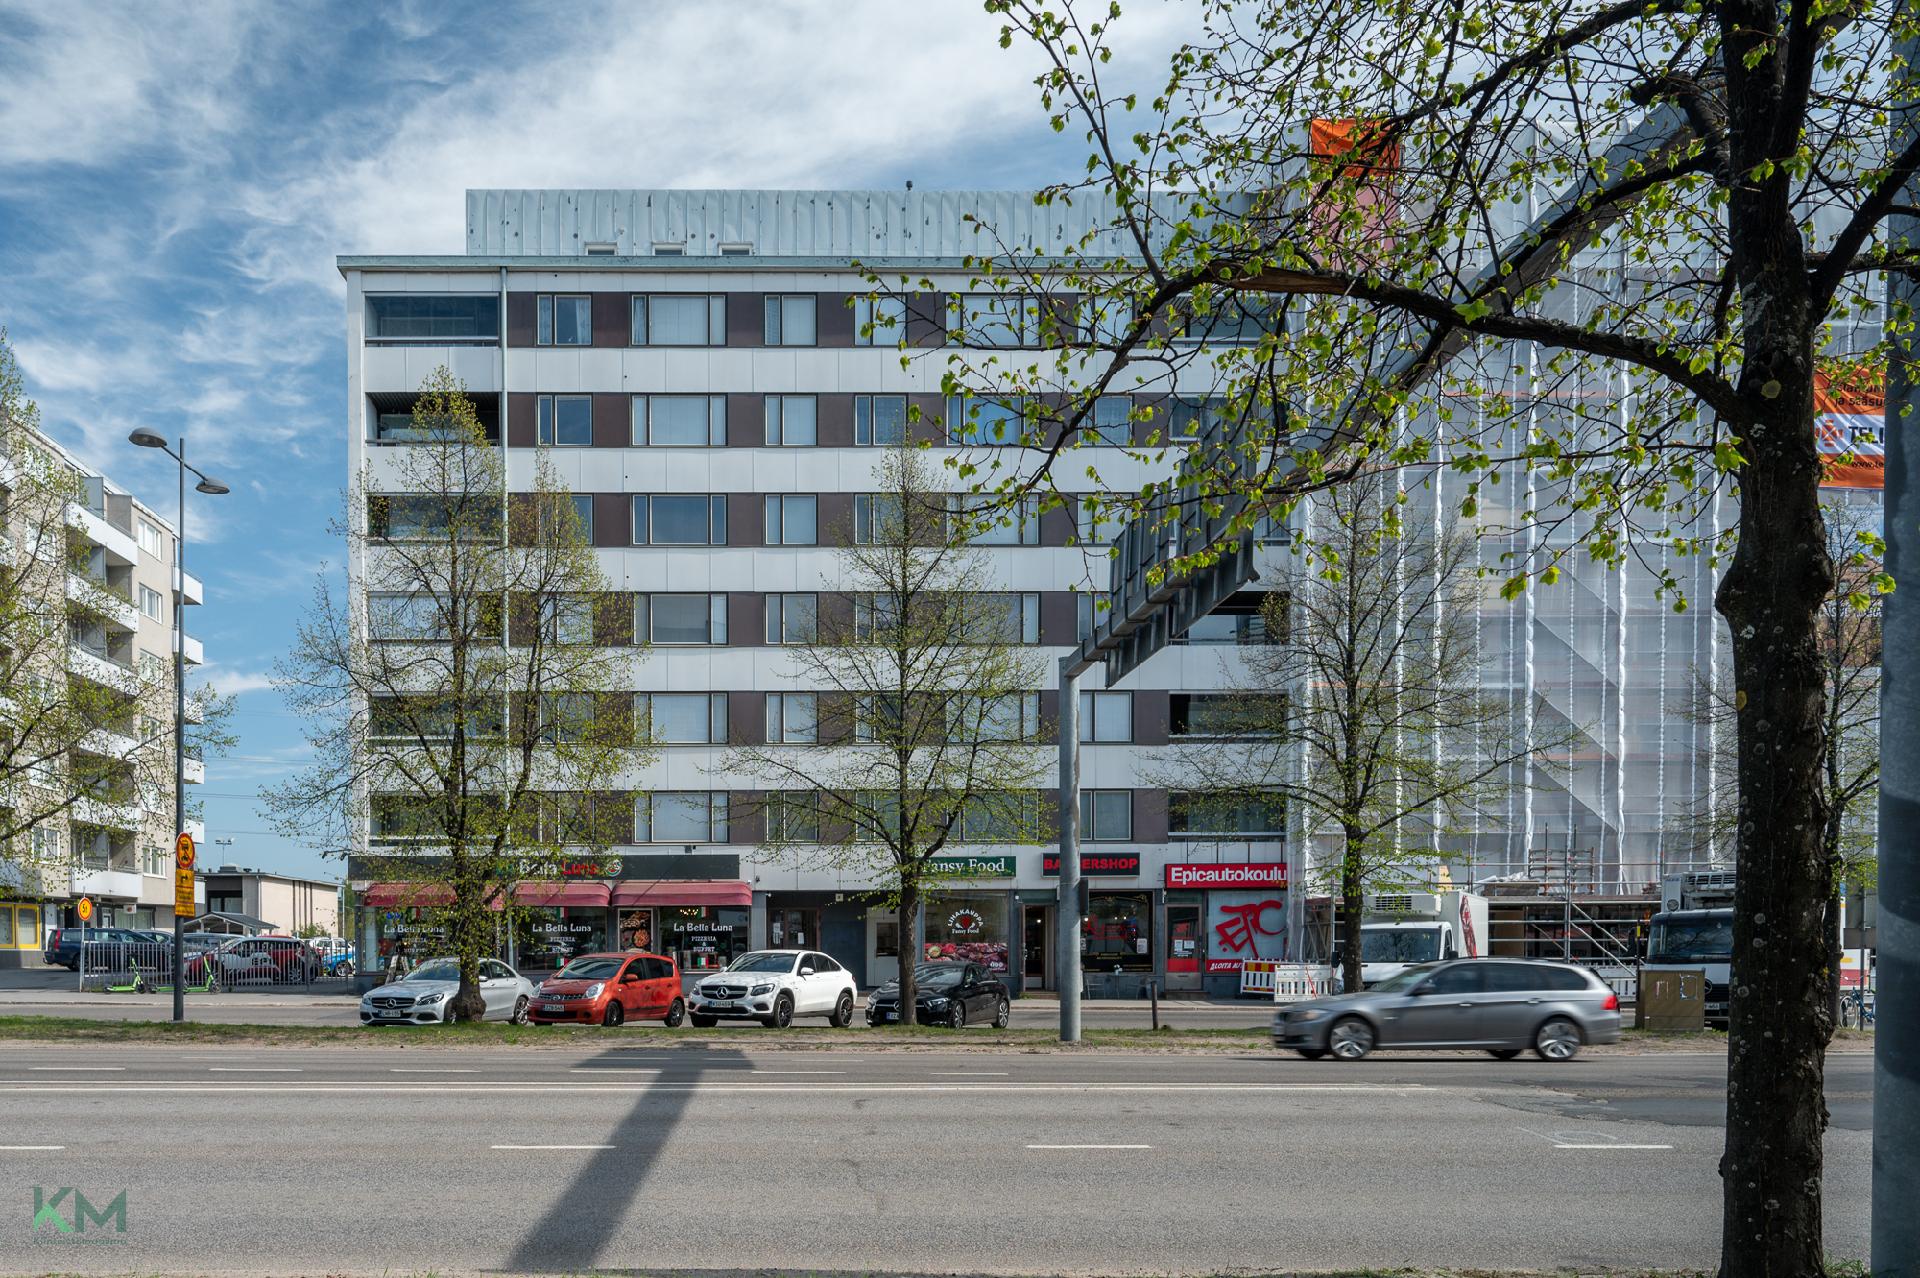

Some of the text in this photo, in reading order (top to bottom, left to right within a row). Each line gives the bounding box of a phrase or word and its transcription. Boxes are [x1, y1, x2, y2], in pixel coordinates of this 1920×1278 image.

[969, 858, 1005, 872] Food
[1043, 857, 1138, 870] BAERSHOP
[1171, 866, 1287, 885] Epicautokoulu
[532, 923, 592, 932] La Bella Luna
[673, 922, 733, 932] La Bella Luna
